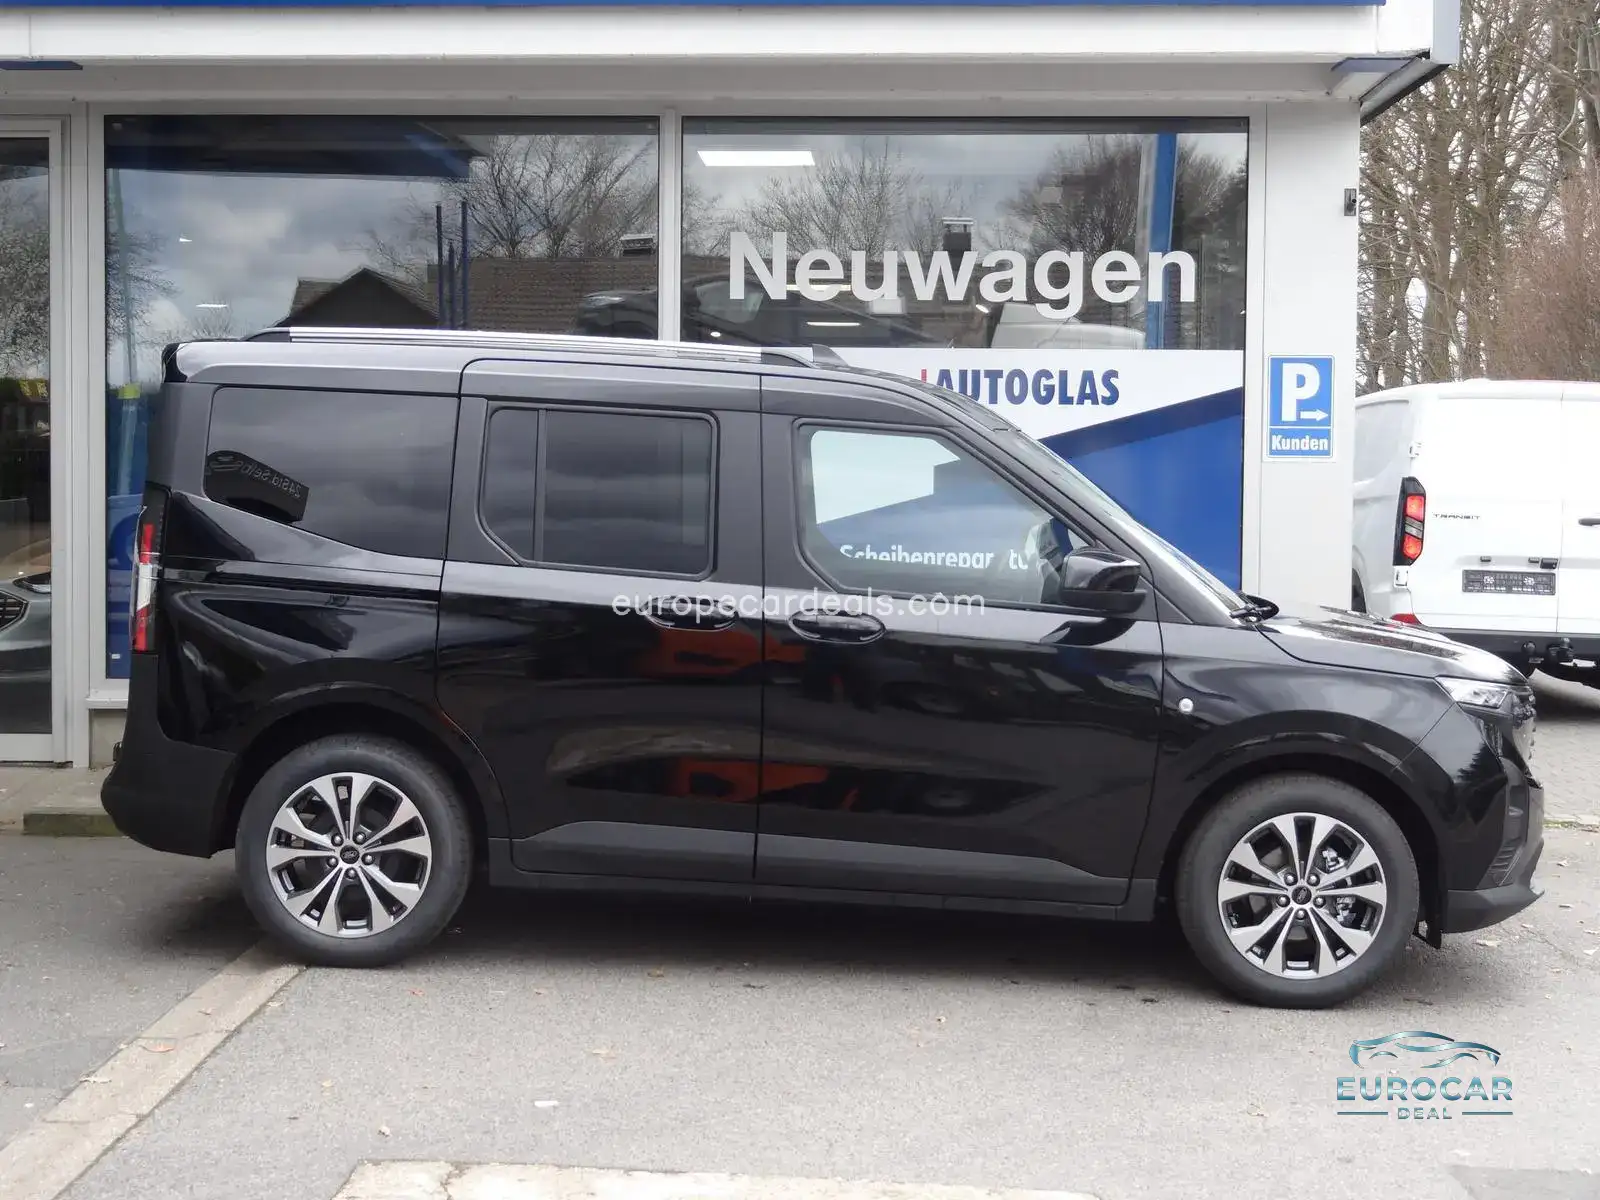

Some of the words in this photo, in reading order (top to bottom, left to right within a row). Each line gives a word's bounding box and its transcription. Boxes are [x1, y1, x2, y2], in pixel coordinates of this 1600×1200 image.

[728, 231, 1197, 319] Neuwagen
[936, 368, 1120, 406] AUTOGLAS
[1281, 362, 1320, 421] P
[1271, 434, 1329, 451] Kunden
